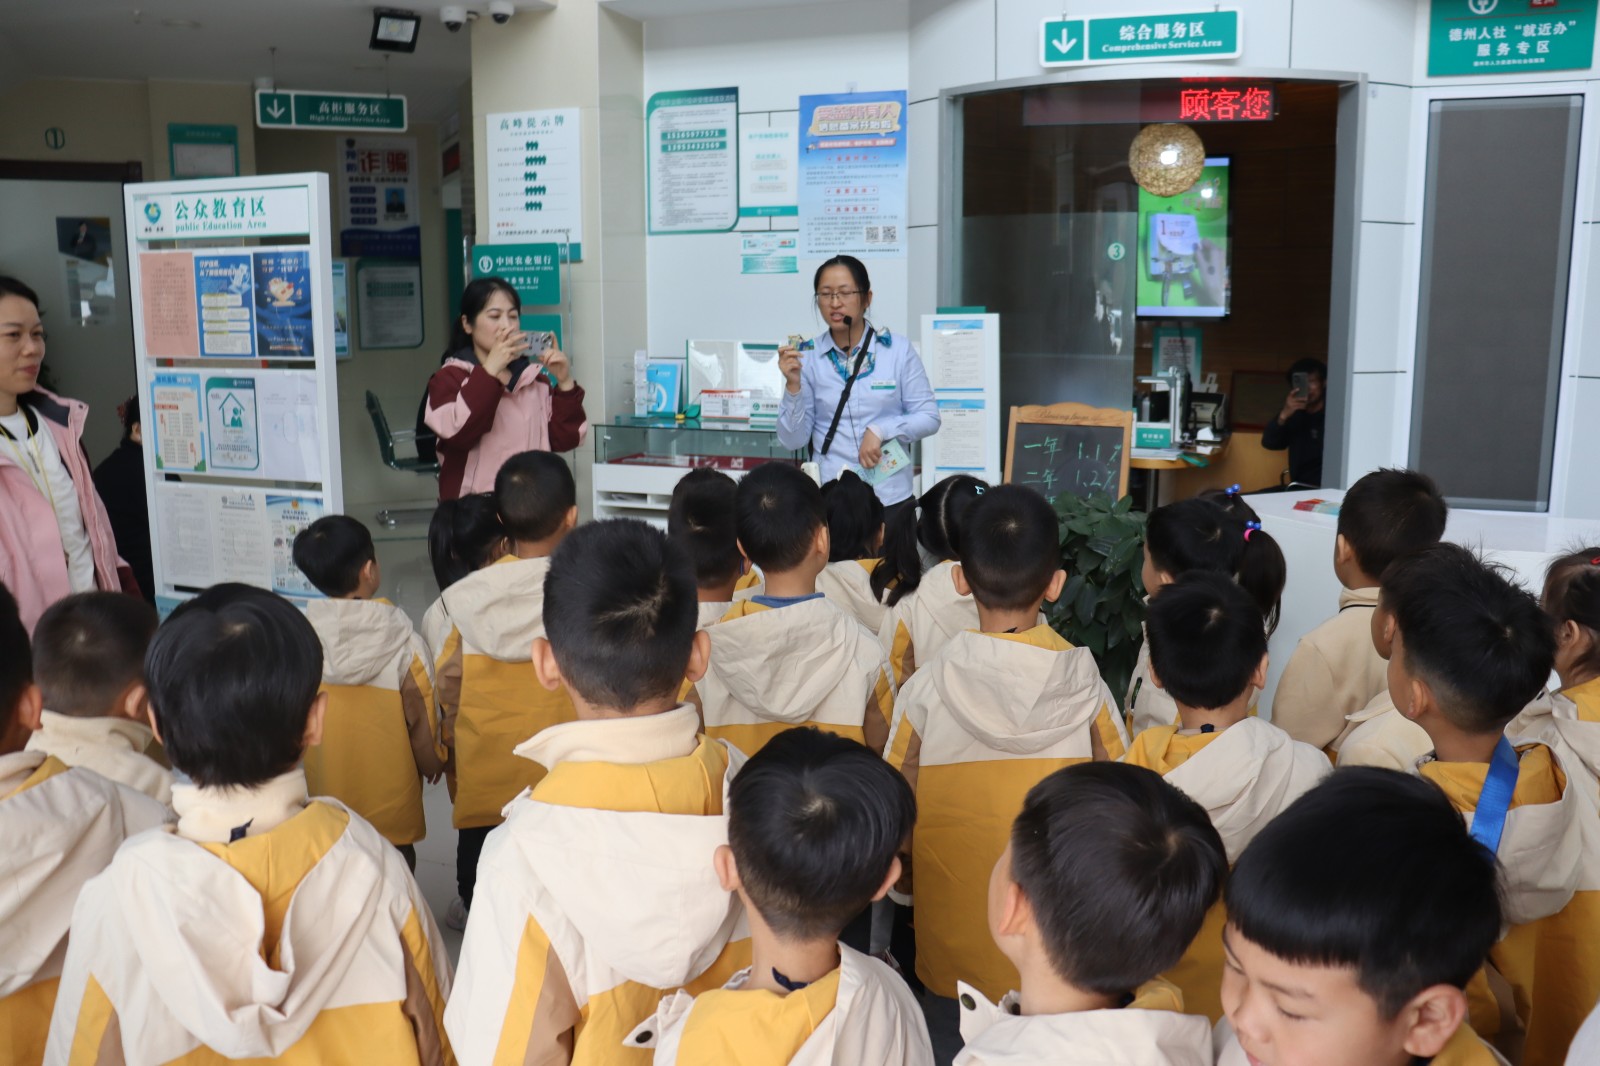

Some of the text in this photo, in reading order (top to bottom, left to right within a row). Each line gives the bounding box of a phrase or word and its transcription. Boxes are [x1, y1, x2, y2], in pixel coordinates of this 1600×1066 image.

[1119, 21, 1205, 41] 综合服务区
[1449, 26, 1507, 42] 德州人社
[1102, 39, 1222, 53] Comprehensive Service Area
[1477, 40, 1550, 57] 服务专区
[319, 100, 381, 116] 高柜服务区
[1180, 88, 1270, 121] 顾客您
[309, 114, 325, 122] High
[500, 115, 564, 131] 高峰提示牌
[360, 150, 408, 174] 诈骗
[175, 196, 267, 220] 公众教育区
[175, 222, 200, 234] public
[203, 221, 242, 231] Education
[247, 219, 267, 229] Area
[496, 255, 552, 267] 中国农业银行
[1024, 436, 1062, 465] 一年
[1022, 469, 1058, 490] 二年
